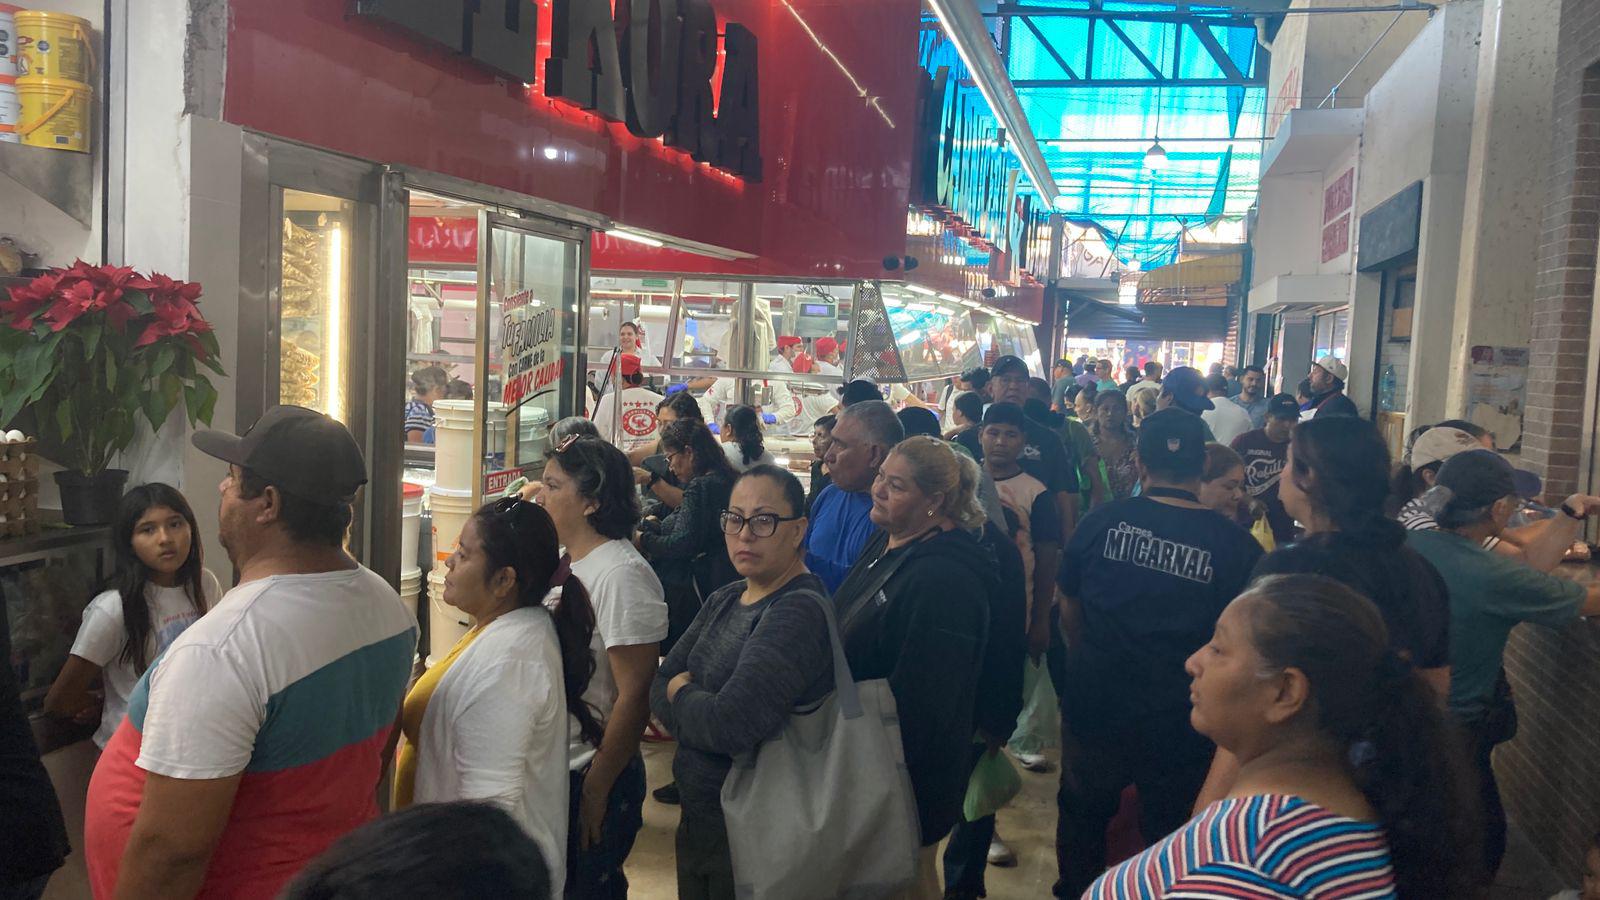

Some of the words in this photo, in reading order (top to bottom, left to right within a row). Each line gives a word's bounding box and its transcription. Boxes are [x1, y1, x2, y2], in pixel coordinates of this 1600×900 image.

[511, 308, 555, 358] FAMILIA
[503, 370, 533, 407] MEJOR
[1119, 521, 1153, 538] Carnes
[1103, 528, 1134, 562] MI
[1132, 535, 1213, 584] CARNAL
